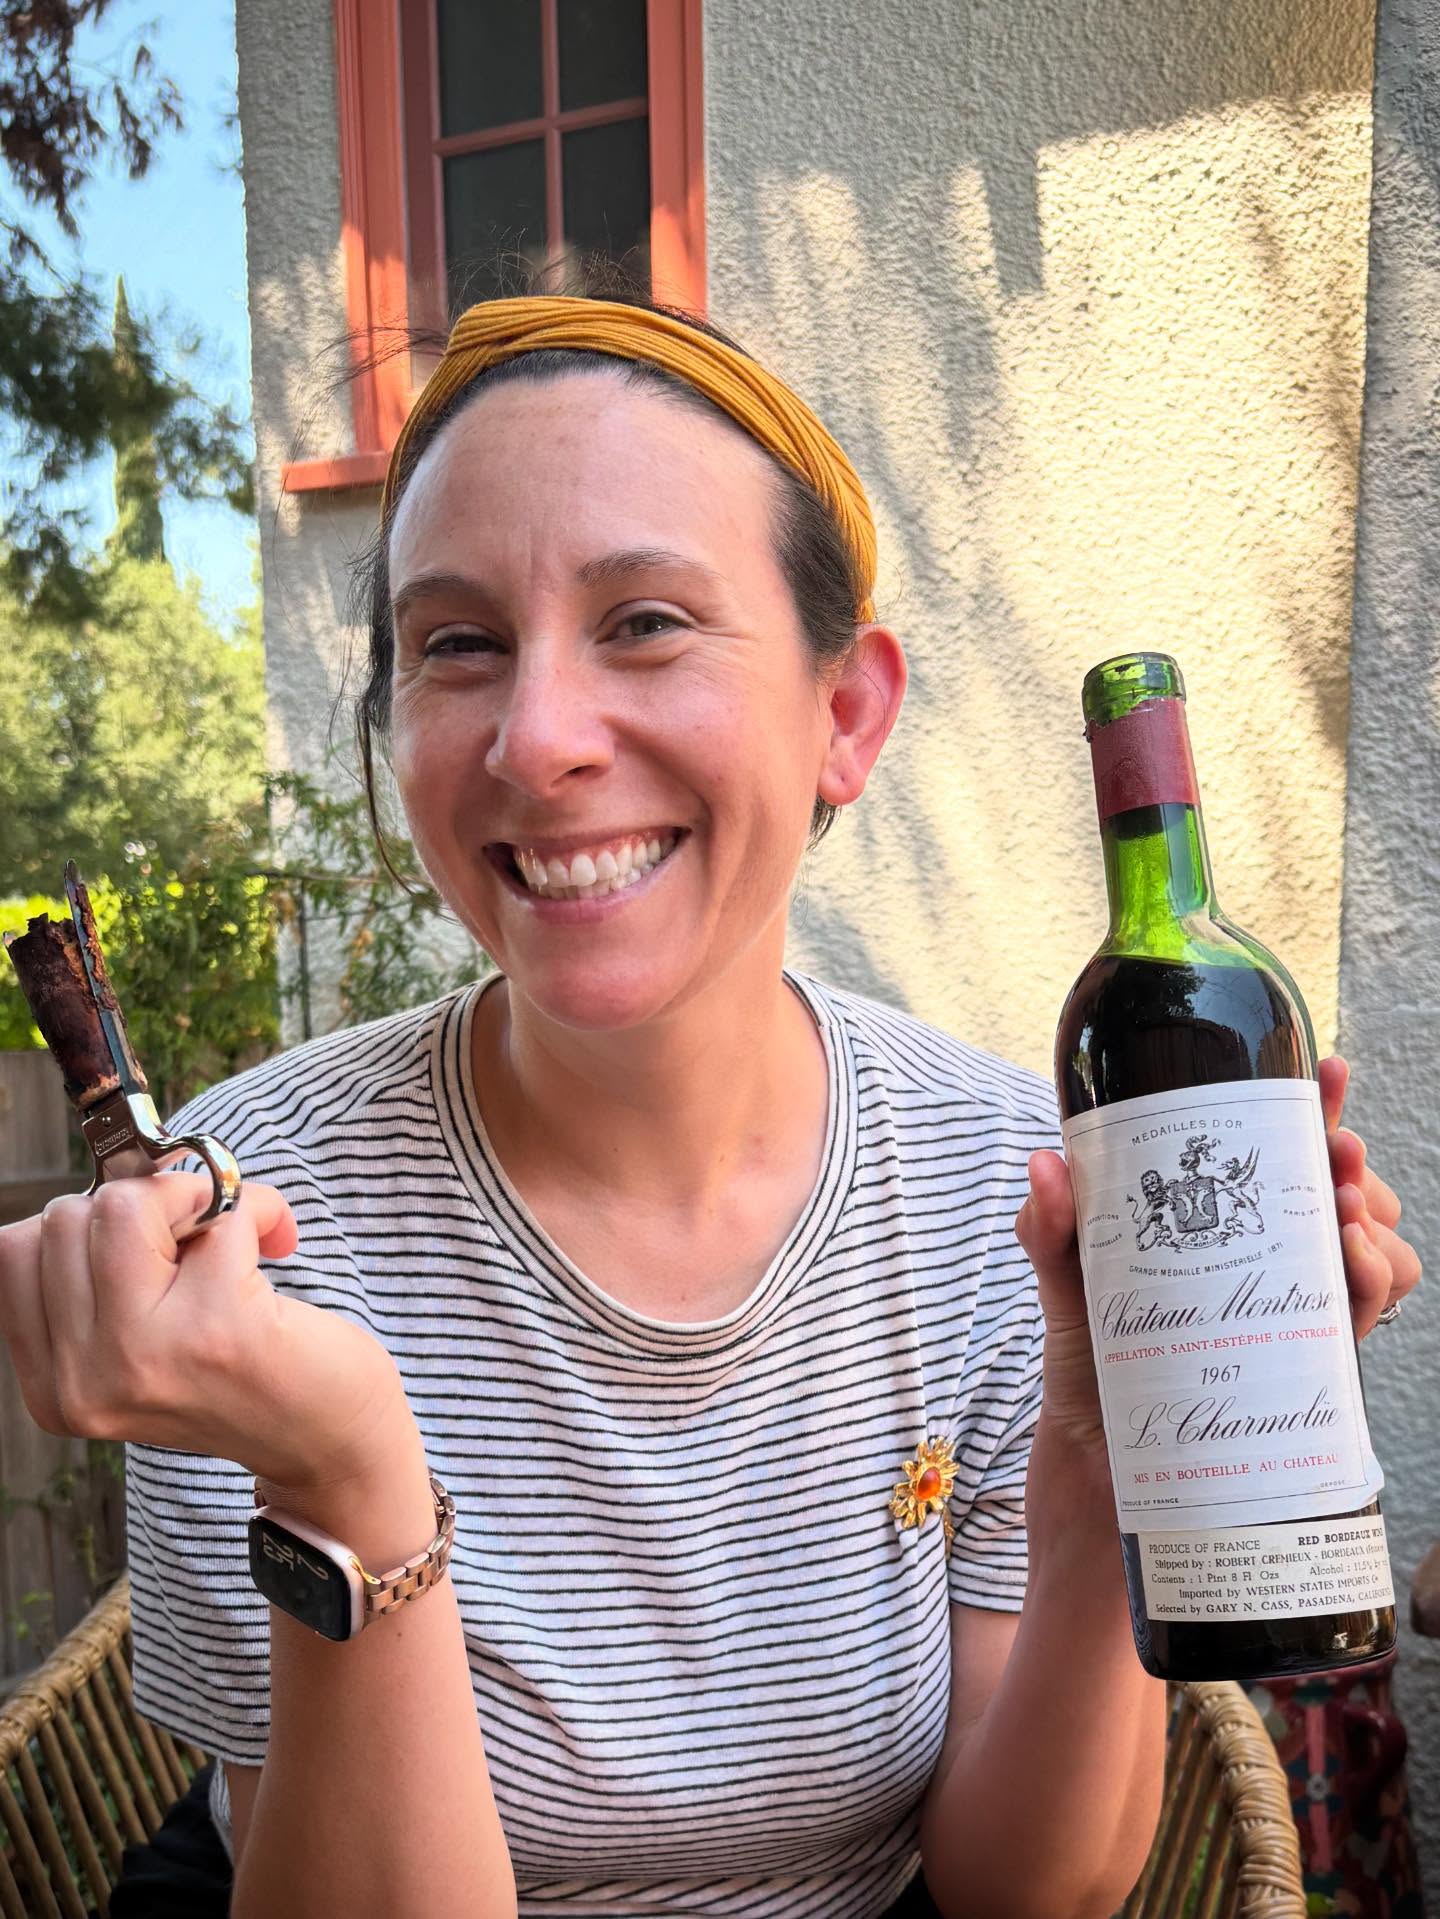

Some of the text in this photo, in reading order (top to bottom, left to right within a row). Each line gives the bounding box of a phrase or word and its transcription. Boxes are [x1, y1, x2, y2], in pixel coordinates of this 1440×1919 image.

[1097, 1269, 1336, 1341] Château Montrose
[1104, 1345, 1166, 1364] APPELLATION
[1200, 1364, 1241, 1385] 1967
[1124, 1401, 1167, 1449] L.
[1134, 1454, 1338, 1484] MIS EN BOUTEILLE AU CHATEAU
[1153, 1497, 1179, 1505] FRANCE
[1148, 1540, 1261, 1554] PRODUCE OF FRANCE
[1297, 1536, 1319, 1546] RED
[1324, 1529, 1371, 1544] BORDEAUX
[1155, 1559, 1189, 1570] Shipped
[1191, 1558, 1205, 1570] by
[1215, 1556, 1256, 1568] ROBERT
[1261, 1551, 1312, 1565] CREMIEUX
[1321, 1545, 1366, 1560] BORDEAUX
[1151, 1574, 1186, 1583] Contents
[1207, 1573, 1227, 1583] Pint
[1231, 1572, 1238, 1582] 8
[1242, 1571, 1252, 1582] Fl
[1260, 1570, 1280, 1580] Ozs
[1309, 1563, 1344, 1576] Alcohol
[1179, 1588, 1222, 1599] Imported
[1227, 1588, 1241, 1599] by
[1246, 1584, 1295, 1596] WESTERN
[1300, 1581, 1335, 1593] STATES
[1338, 1575, 1369, 1589] IMPORTS
[1156, 1603, 1187, 1613] Selected
[1190, 1604, 1201, 1615] by
[1206, 1603, 1238, 1613] GARY
[1243, 1602, 1256, 1613] N.
[1261, 1599, 1293, 1611] CASS,
[1297, 1594, 1355, 1608] PASADENA,
